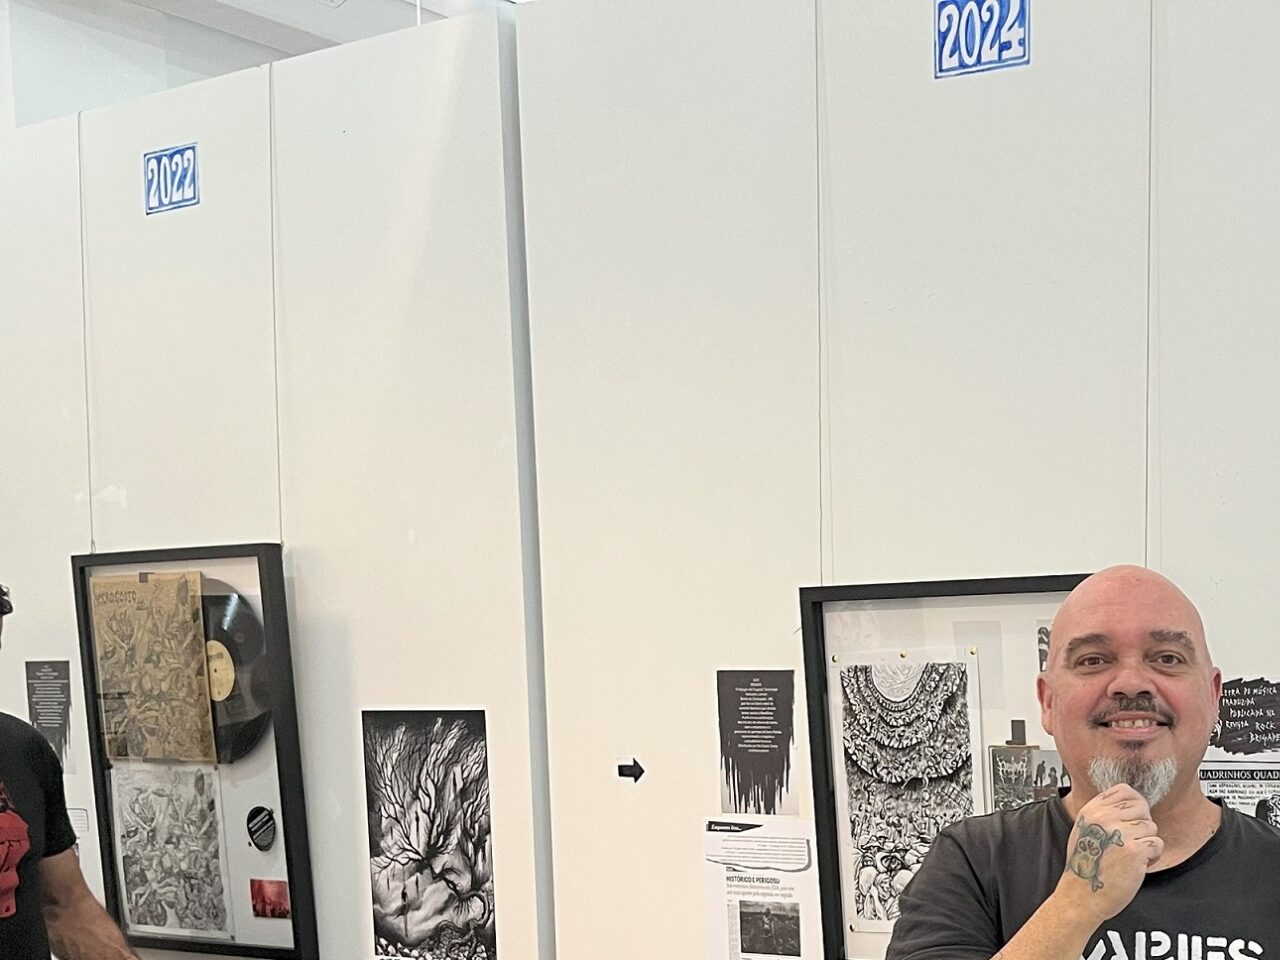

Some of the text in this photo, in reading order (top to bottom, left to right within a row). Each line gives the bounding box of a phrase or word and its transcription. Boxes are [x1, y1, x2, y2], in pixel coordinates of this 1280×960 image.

[939, 0, 1025, 70] 2024
[148, 148, 195, 208] 2022
[1255, 721, 1276, 731] ROCK
[1200, 771, 1251, 780] UADRINHOS
